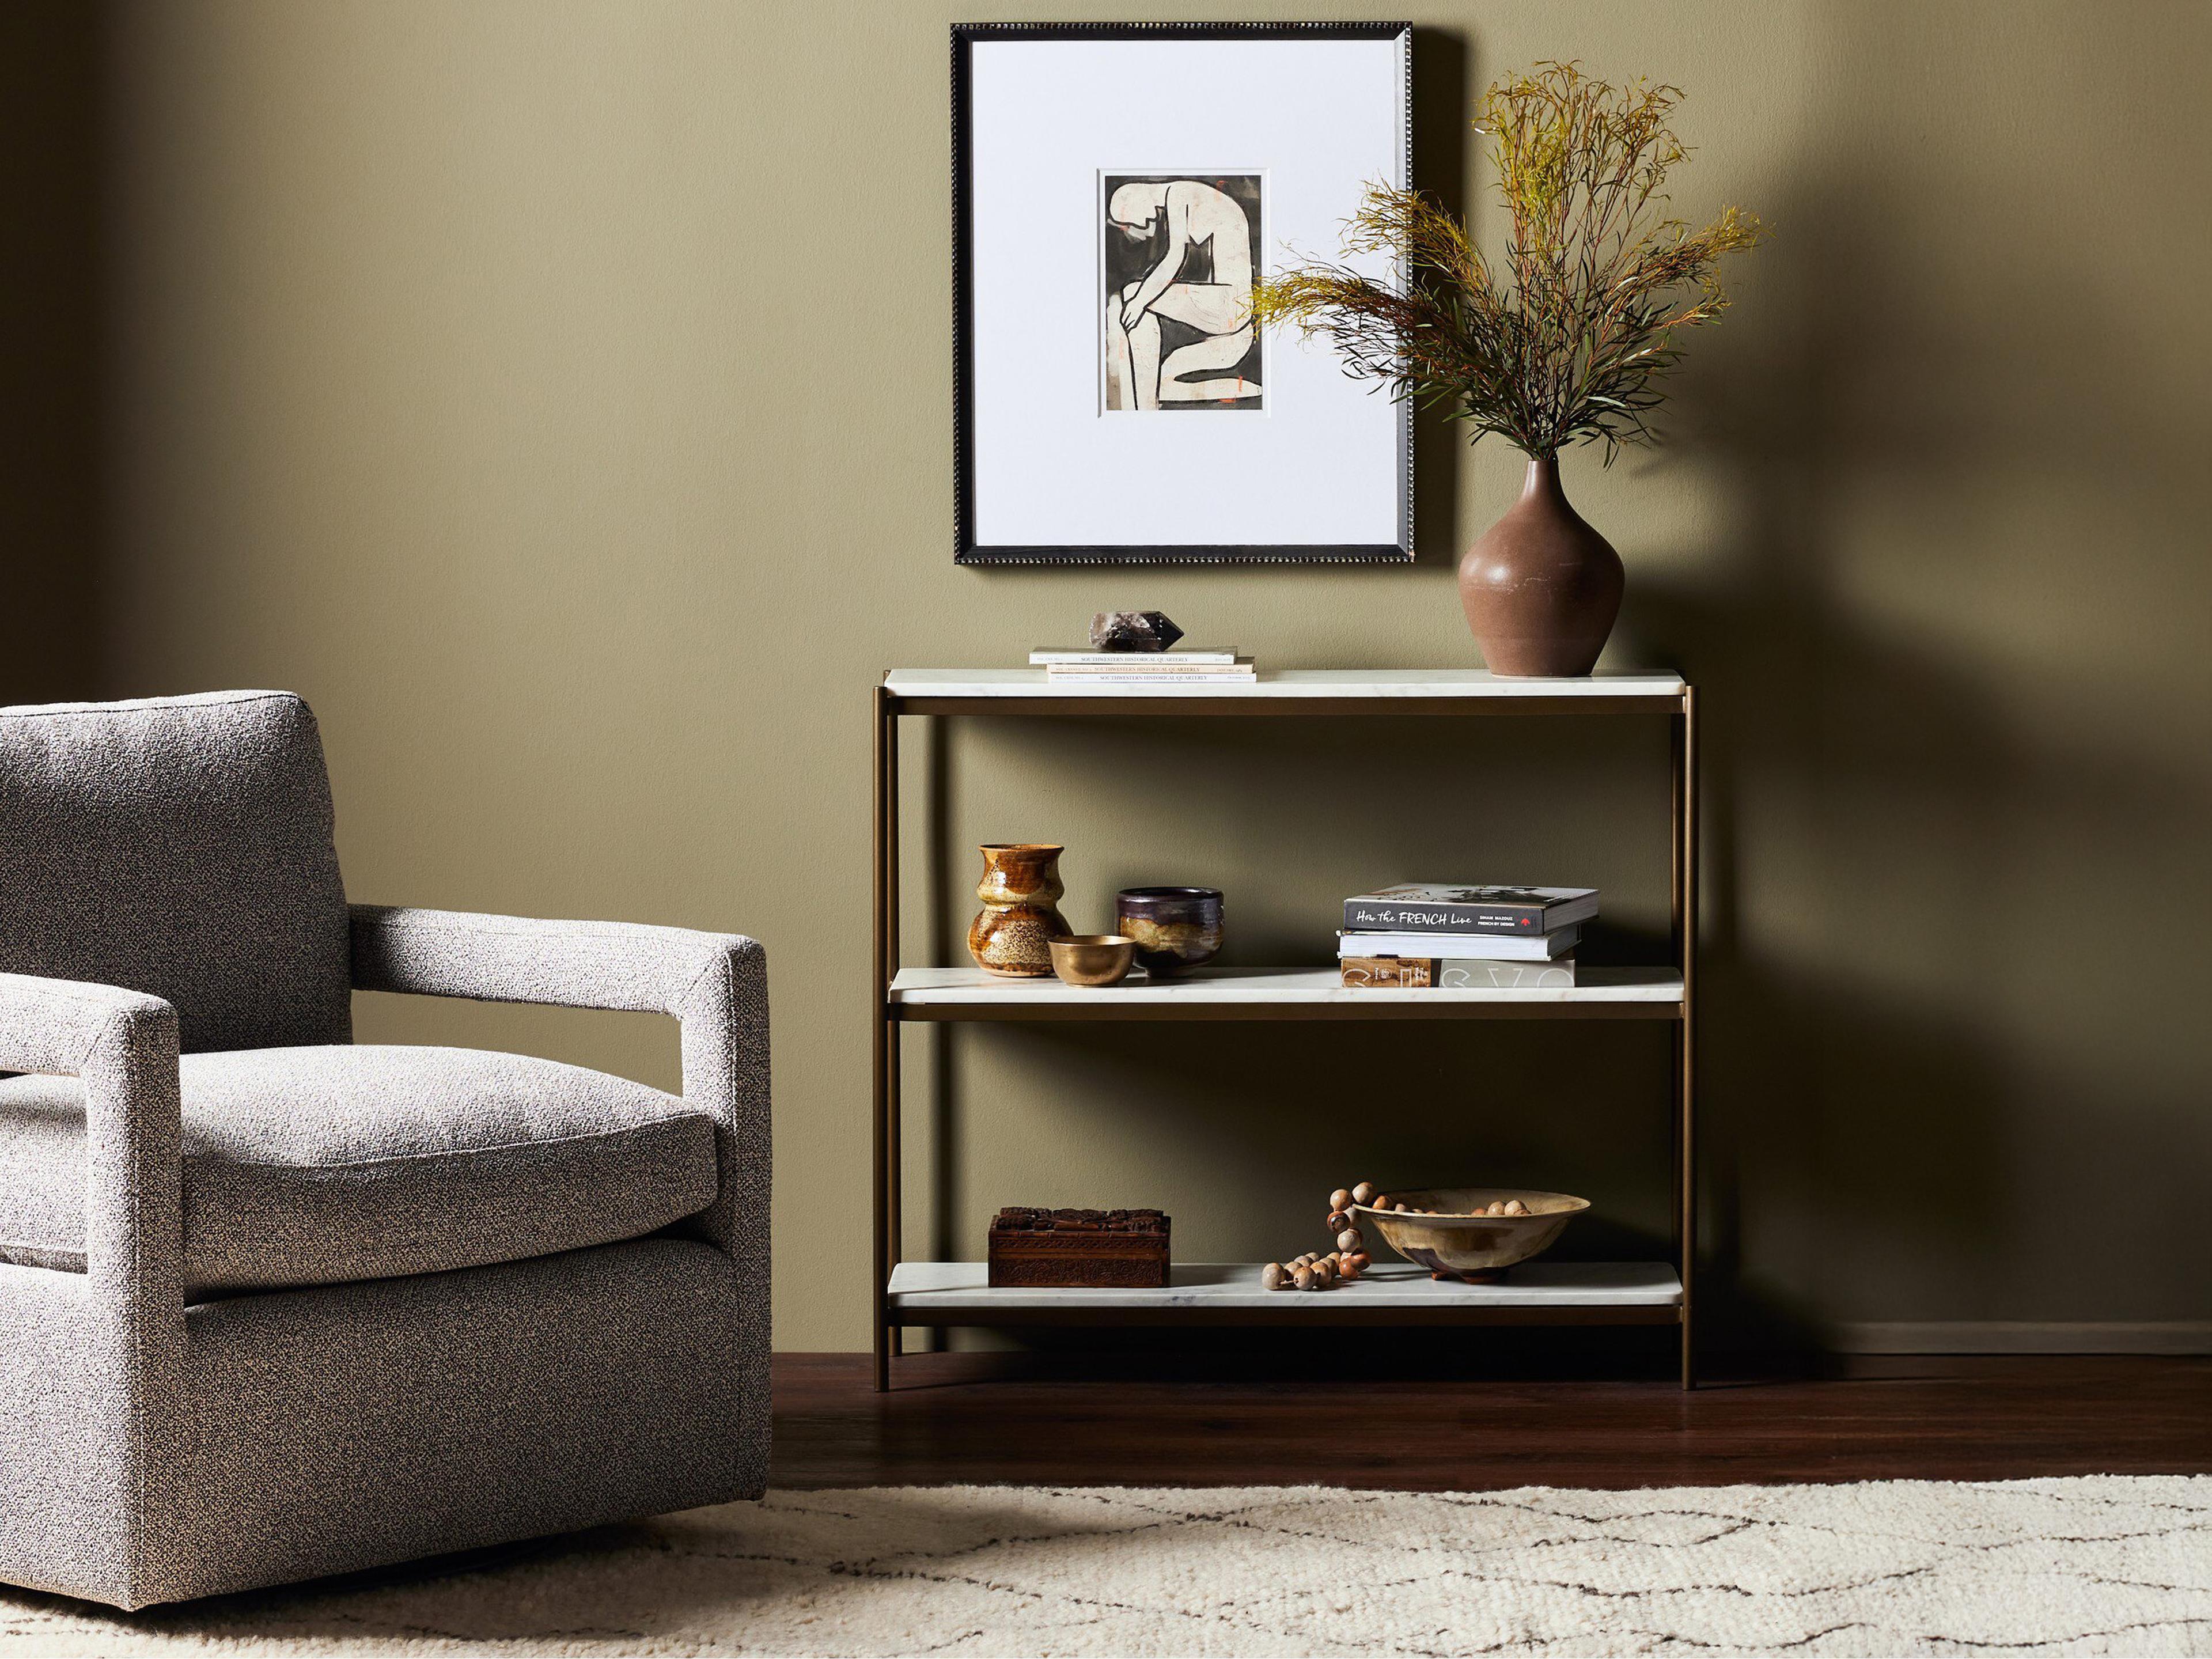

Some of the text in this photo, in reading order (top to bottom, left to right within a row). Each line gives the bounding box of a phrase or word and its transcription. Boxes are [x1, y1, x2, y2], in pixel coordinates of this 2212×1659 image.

[1356, 910, 1472, 925] How the FRENCH Live
